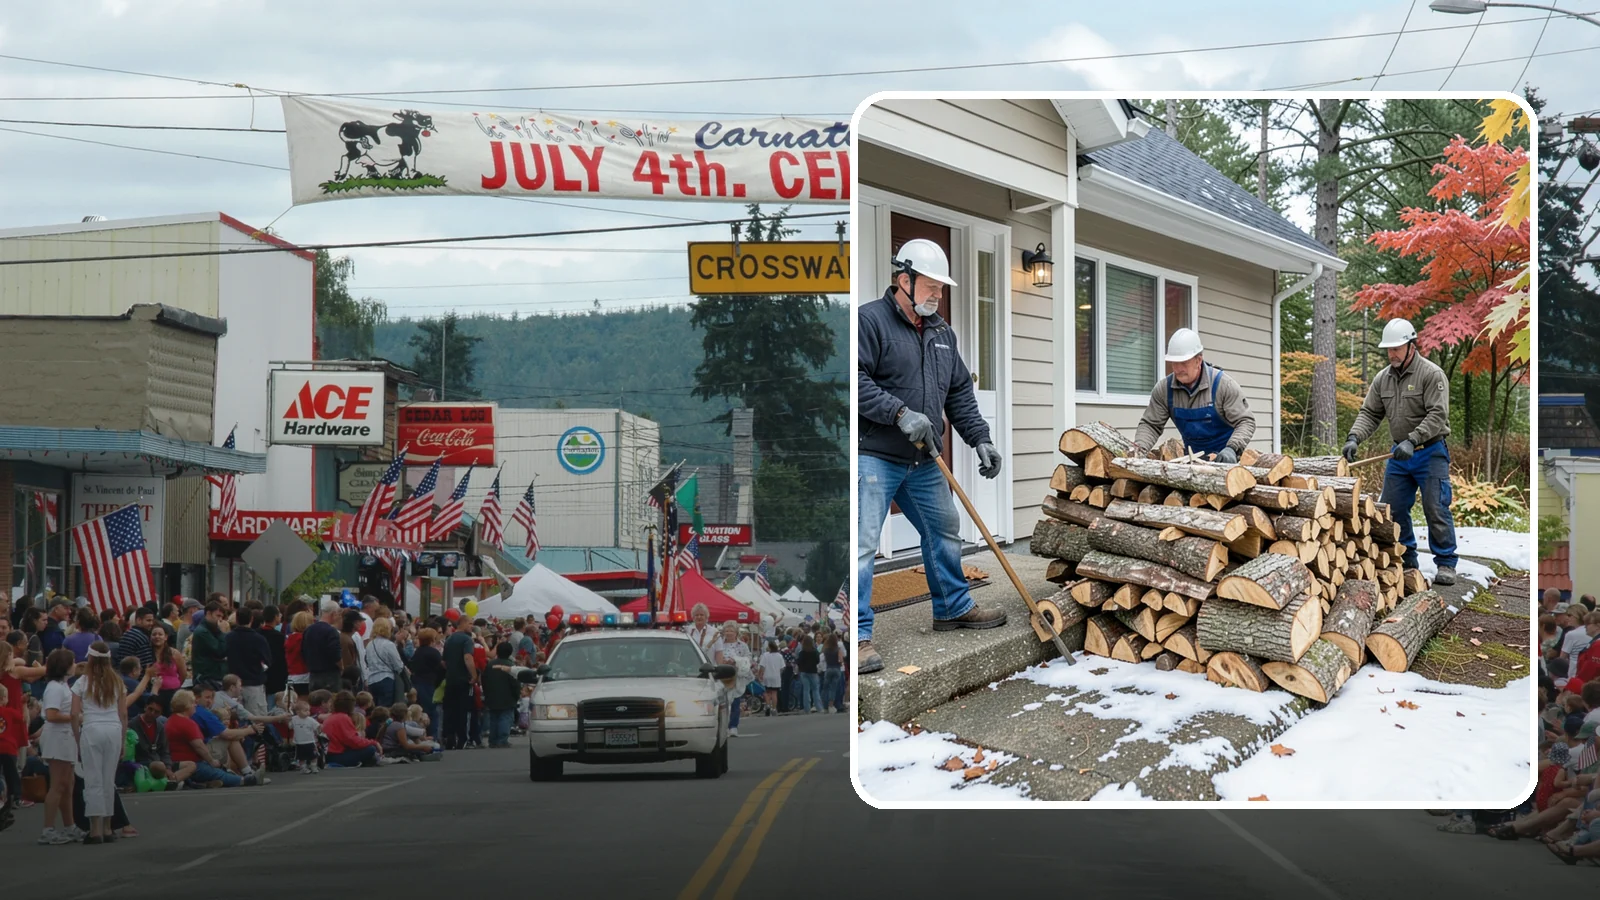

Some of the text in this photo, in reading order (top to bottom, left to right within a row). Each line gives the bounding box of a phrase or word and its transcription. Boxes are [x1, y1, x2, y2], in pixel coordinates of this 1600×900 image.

[694, 121, 850, 150] Carnat
[481, 141, 605, 192] JULY
[632, 149, 746, 198] 4th.
[696, 254, 850, 280] CROSSWA
[282, 380, 373, 420] ACE
[405, 409, 453, 422] CEDAR
[283, 421, 371, 437] Hardware
[416, 428, 477, 447] Coca-Cola
[353, 467, 386, 480] Simpl
[83, 485, 155, 495] St. Vincent de Paul
[81, 503, 154, 522] THT
[688, 526, 741, 535] CRNATION
[699, 535, 730, 543] GLASS
